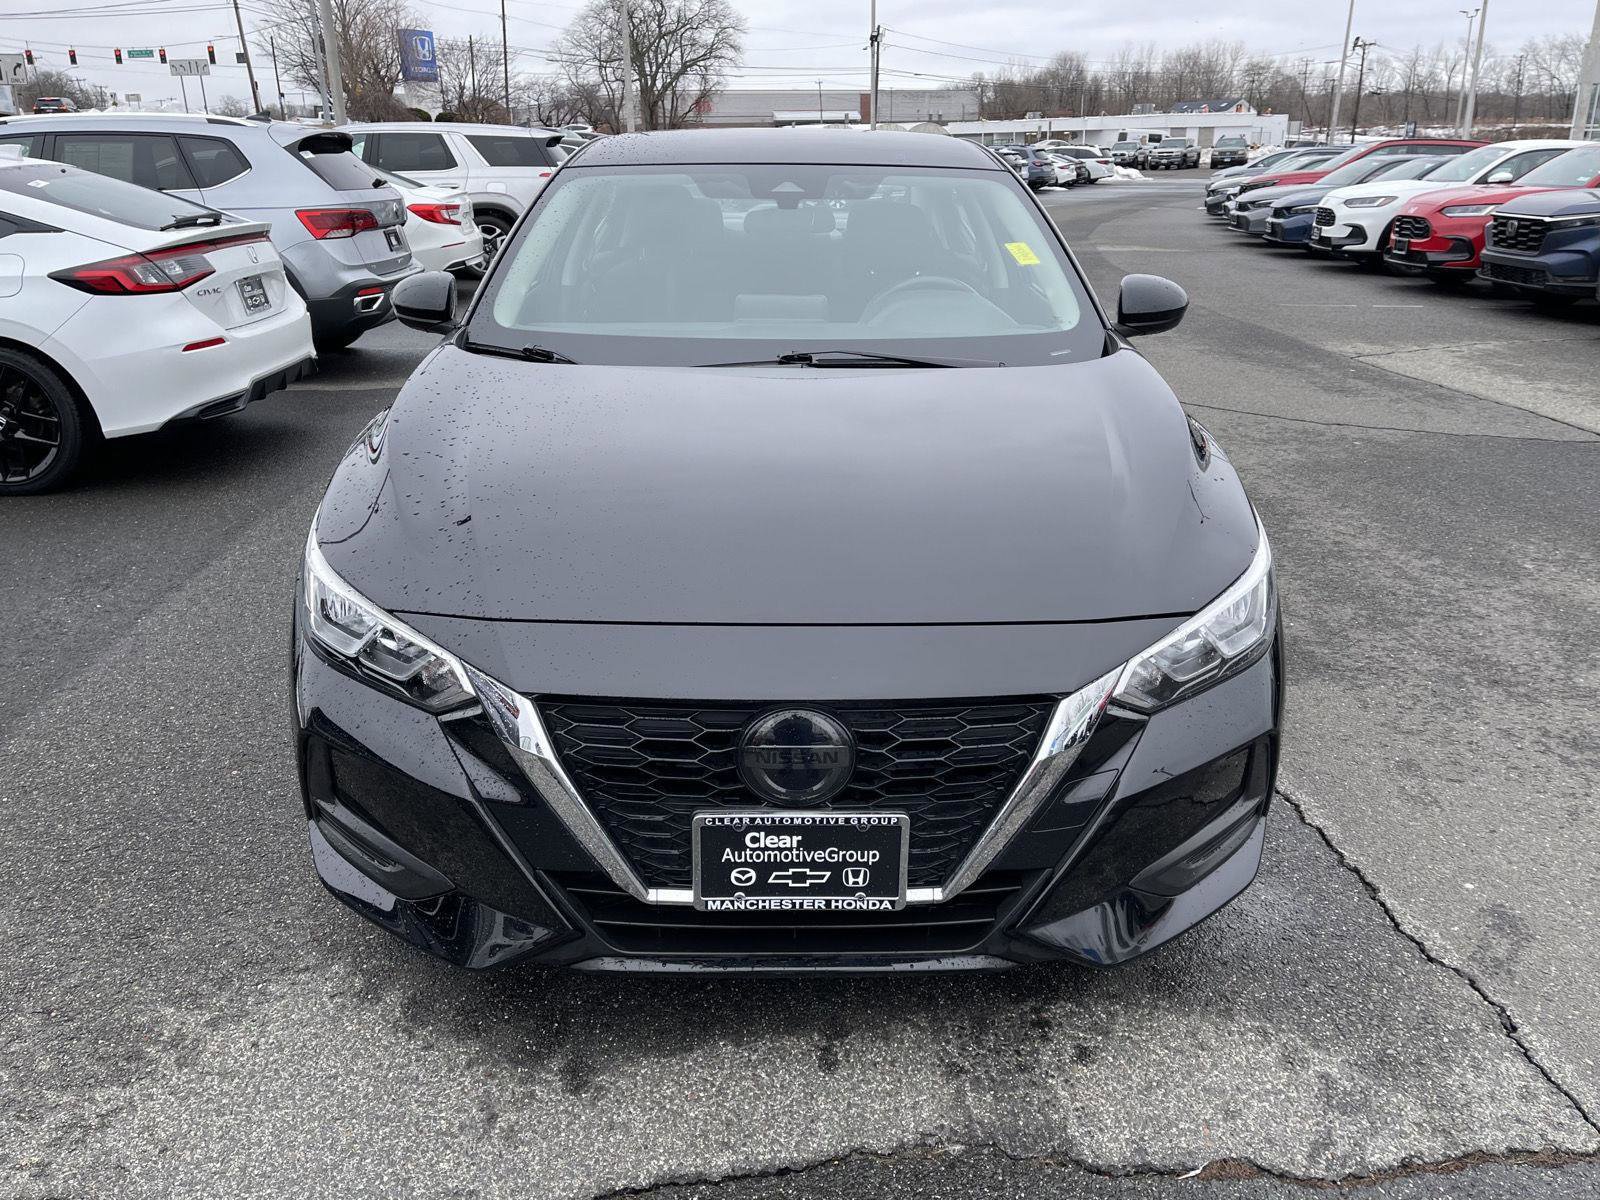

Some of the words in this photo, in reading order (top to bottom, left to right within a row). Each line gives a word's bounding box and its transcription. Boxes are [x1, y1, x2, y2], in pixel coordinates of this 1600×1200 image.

[197, 287, 222, 296] CIVIC
[755, 751, 839, 764] NISSAN
[705, 817, 750, 825] CLEAR
[755, 817, 845, 825] AUTOMOTIVE
[850, 817, 898, 825] GROUP
[744, 831, 802, 848] Clear
[721, 847, 880, 865] AutomotiveGroup
[707, 899, 826, 910] MANCHESTER
[831, 899, 893, 910] HONDA
